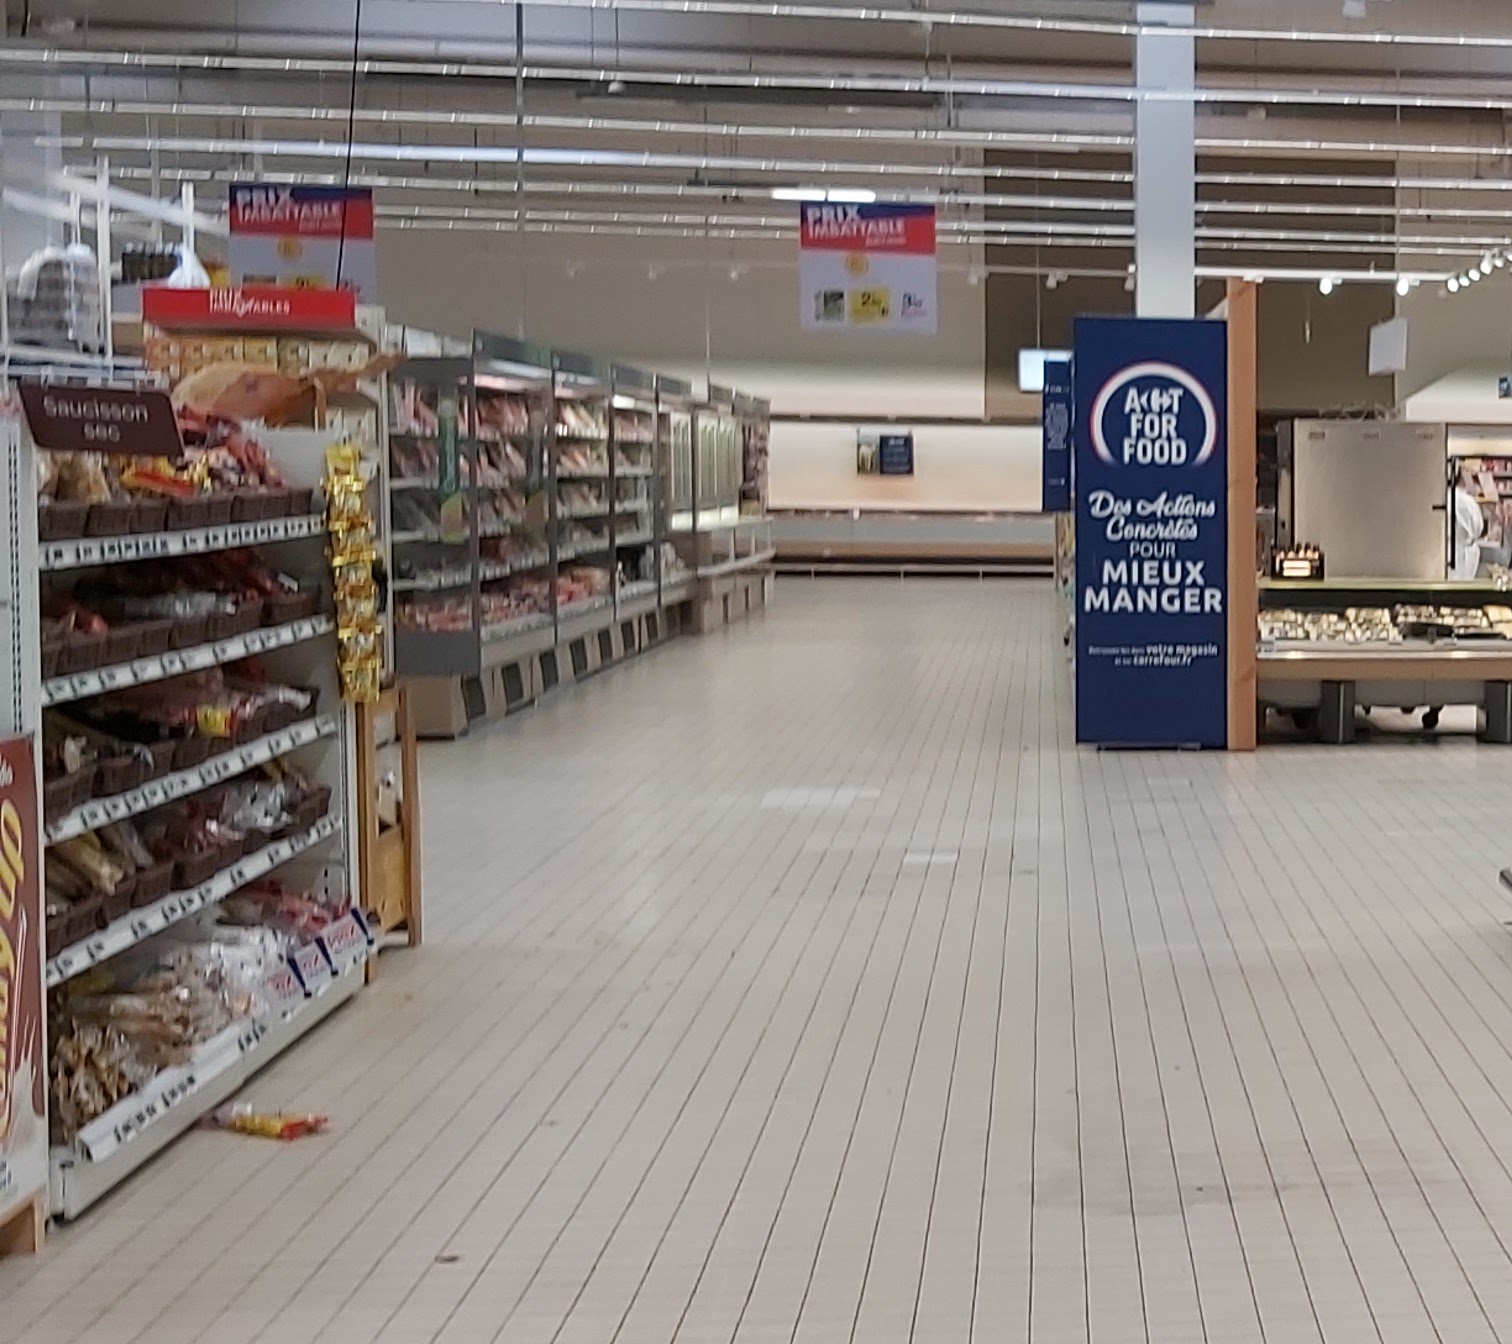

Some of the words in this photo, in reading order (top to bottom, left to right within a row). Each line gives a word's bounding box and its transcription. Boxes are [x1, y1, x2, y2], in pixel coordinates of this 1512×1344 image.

[807, 206, 861, 225] PRIX
[1130, 413, 1177, 439] FOR
[1123, 438, 1187, 465] FOOD
[1130, 541, 1177, 558] POUR
[1102, 559, 1205, 586] MIEUX
[1084, 586, 1223, 614] MANGER
